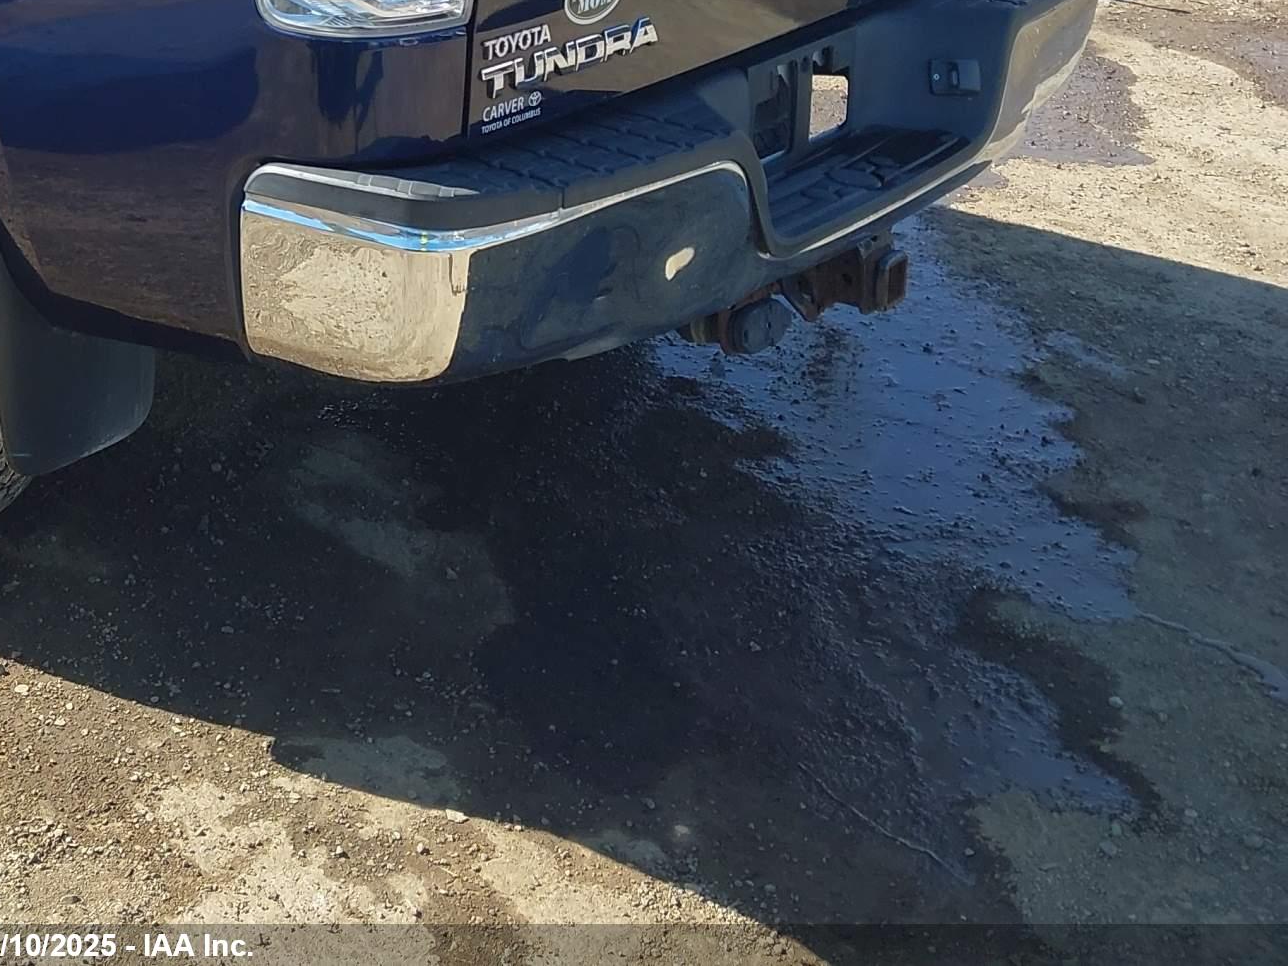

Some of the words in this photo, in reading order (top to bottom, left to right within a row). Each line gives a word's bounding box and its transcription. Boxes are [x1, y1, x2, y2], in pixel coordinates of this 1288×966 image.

[481, 16, 659, 98] TUNDRA
[483, 25, 552, 61] TOYOTA
[481, 120, 503, 134] TOYOTA
[503, 117, 511, 127] OF
[511, 107, 542, 125] COLUMBUS
[482, 97, 525, 122] CARVER
